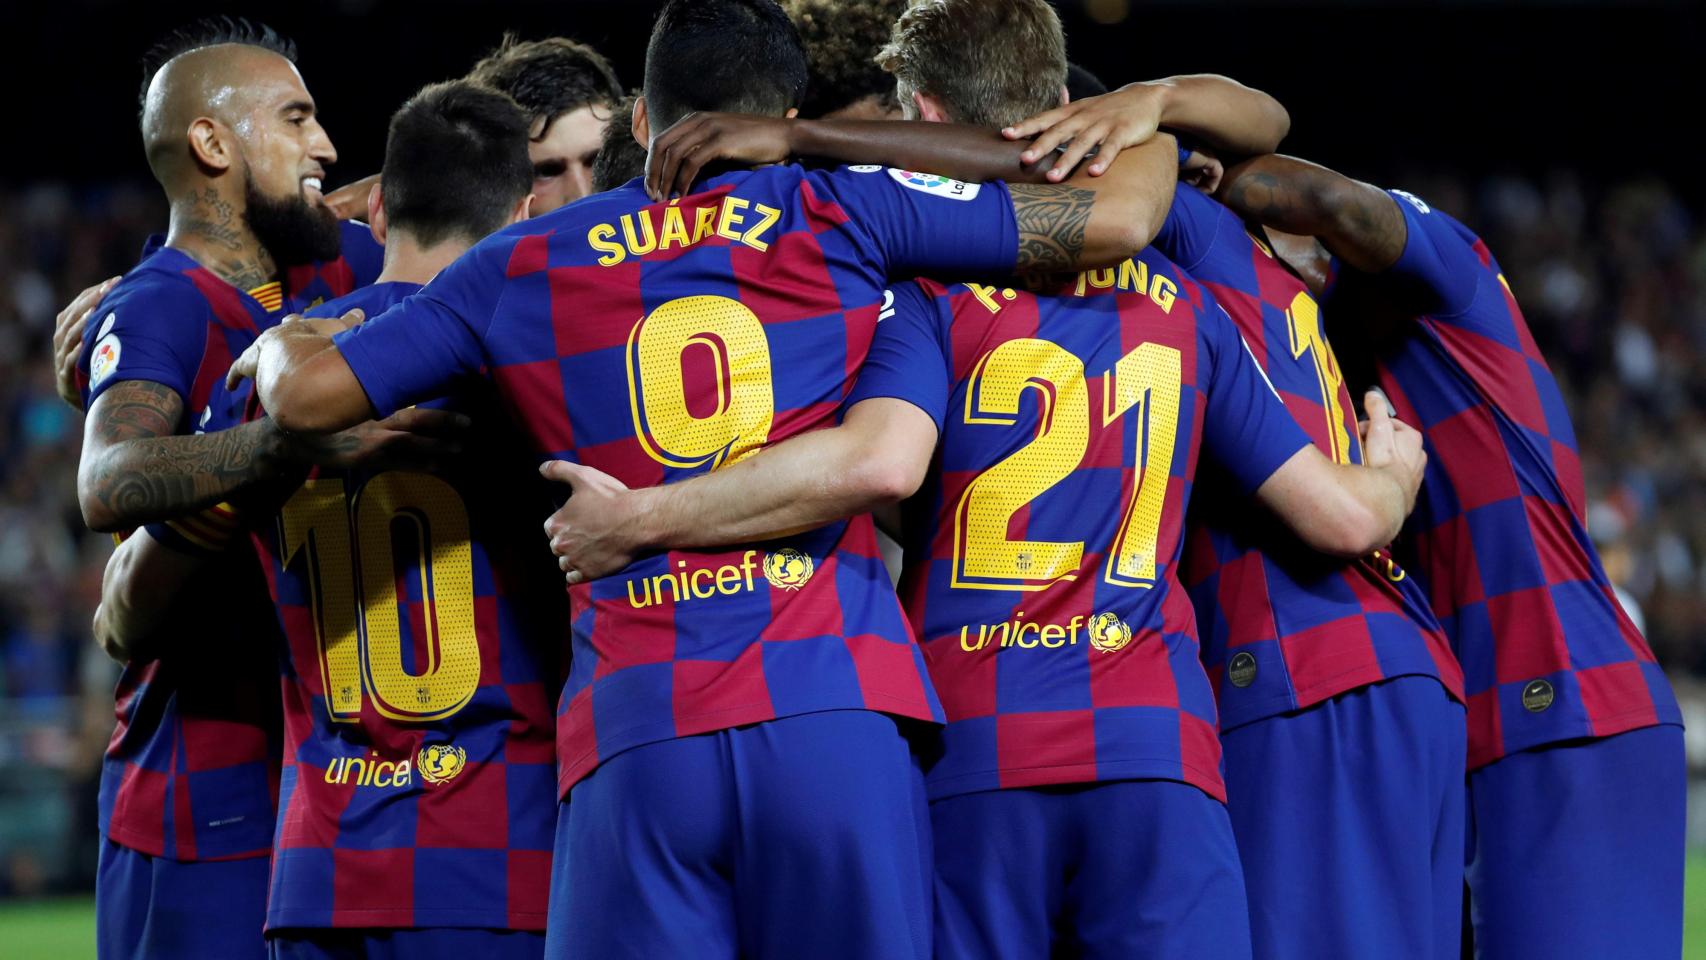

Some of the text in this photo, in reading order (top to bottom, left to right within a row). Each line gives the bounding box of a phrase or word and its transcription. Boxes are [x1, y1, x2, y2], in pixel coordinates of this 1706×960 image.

[587, 196, 782, 267] SUÁREZ
[625, 295, 776, 473] 9
[950, 337, 1182, 592] 21
[276, 470, 481, 723] 10
[627, 550, 758, 609] unicef
[960, 611, 1084, 652] unicef
